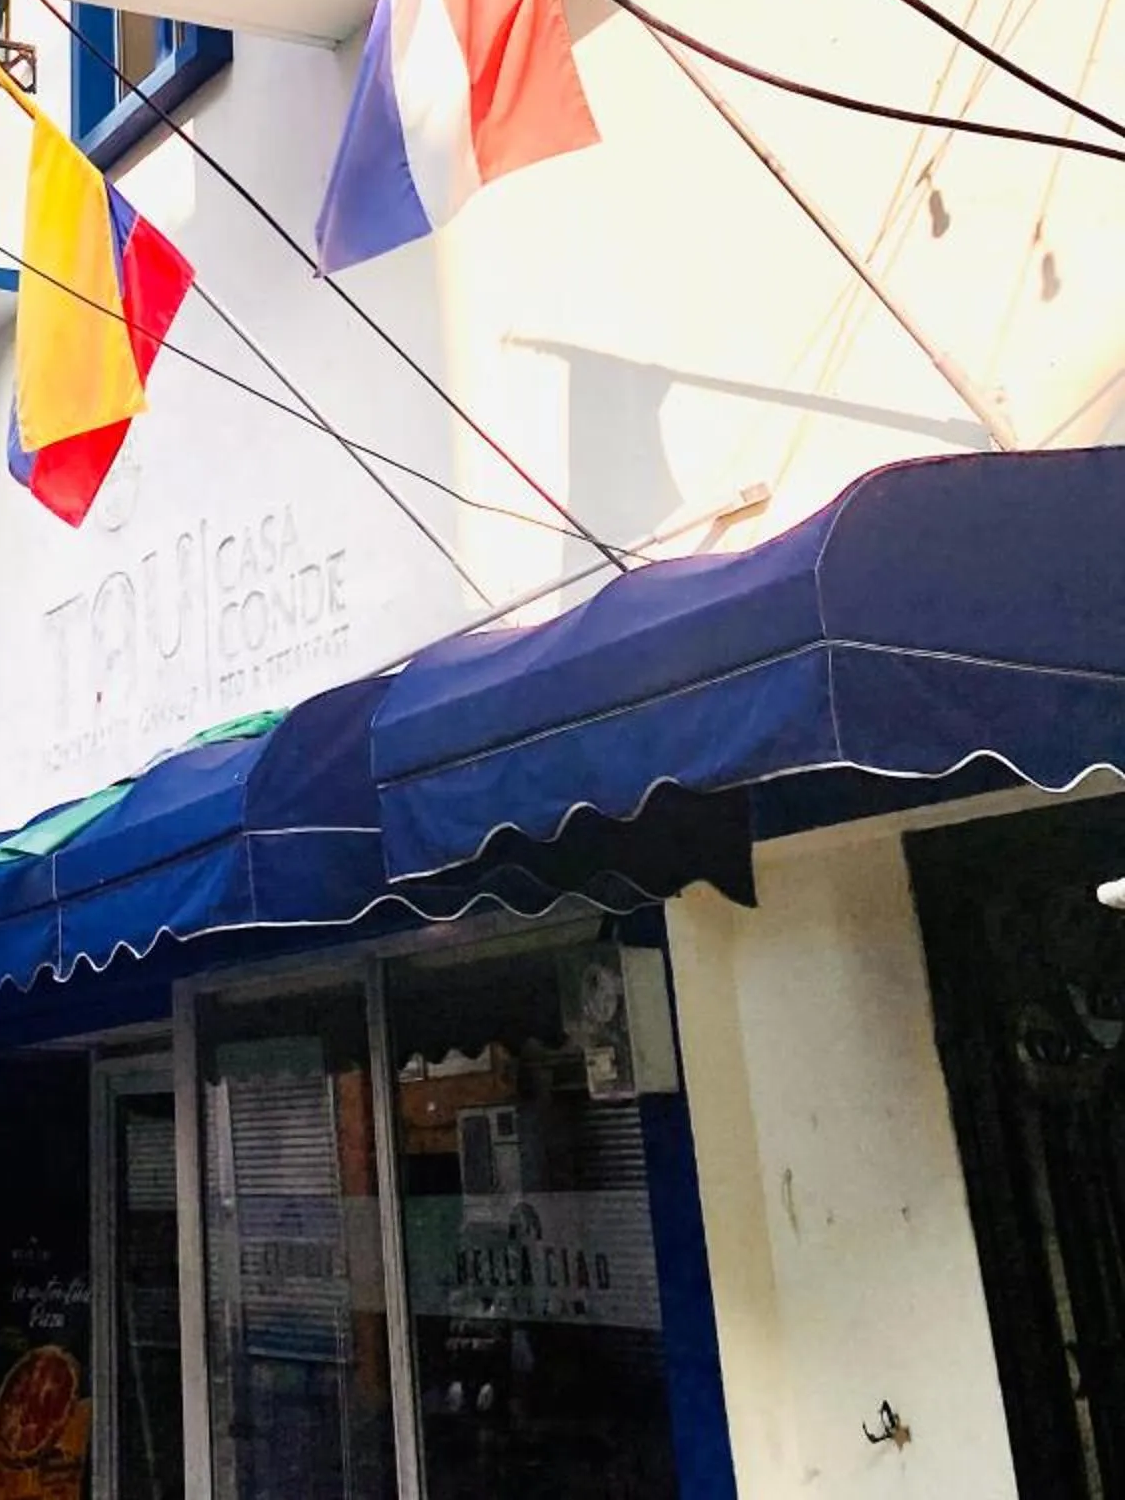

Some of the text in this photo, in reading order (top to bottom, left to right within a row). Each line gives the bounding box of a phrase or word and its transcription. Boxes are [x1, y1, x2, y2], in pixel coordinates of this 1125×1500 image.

[216, 503, 299, 591] CASA
[219, 549, 348, 659] CONDE
[456, 1246, 610, 1290] BELLA CIAO
